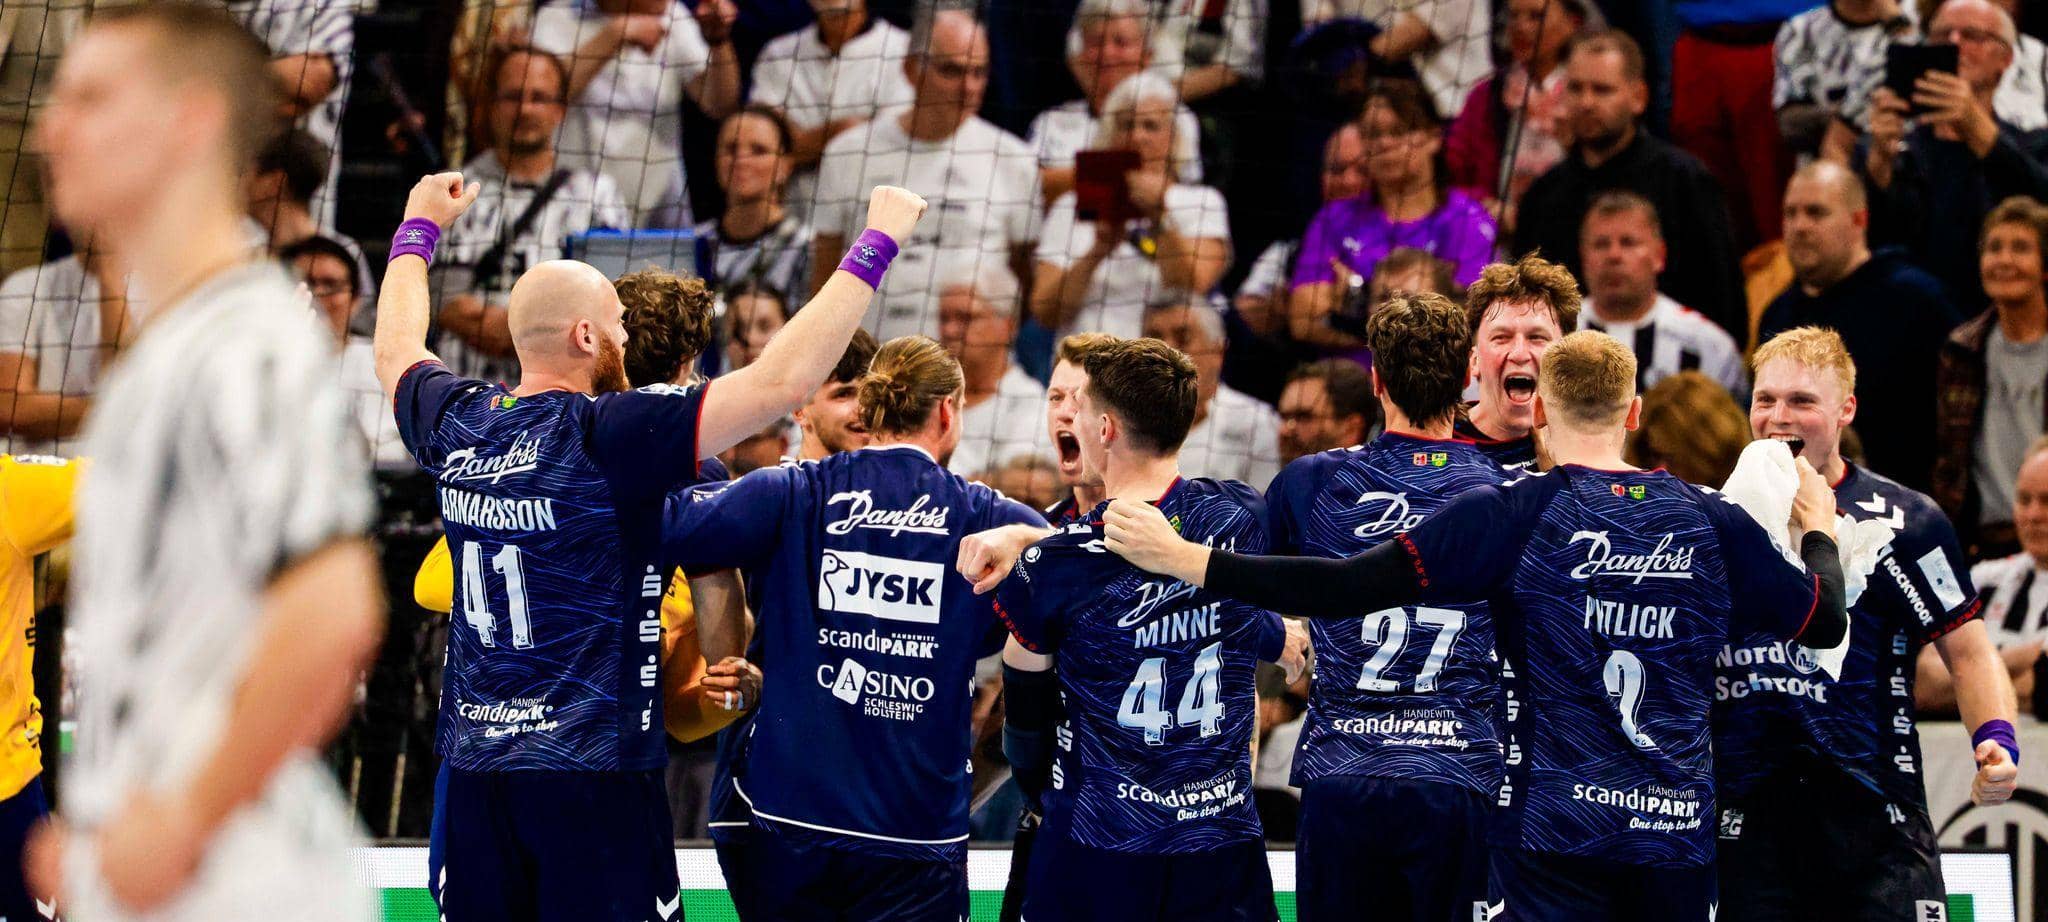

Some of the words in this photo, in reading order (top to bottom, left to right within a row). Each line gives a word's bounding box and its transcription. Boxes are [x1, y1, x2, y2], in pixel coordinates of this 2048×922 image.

[441, 486, 557, 531] ARNARSSON
[827, 490, 950, 537] Danfoss
[1568, 530, 1694, 584] Danfoss
[461, 541, 535, 650] 41
[845, 567, 936, 606] JYSK
[1134, 601, 1221, 649] MINNE
[1356, 605, 1467, 694] 27
[1715, 641, 1786, 669] Nord
[816, 657, 935, 706] CASINO
[1117, 641, 1226, 746] 44
[1714, 672, 1827, 704] Schrott
[864, 697, 924, 714] SCHLESWIG
[864, 706, 915, 721] HOLSTEIN
[1177, 808, 1199, 821] One
[1199, 804, 1221, 818] stop
[1629, 816, 1652, 830] One
[1652, 818, 1675, 833] stop
